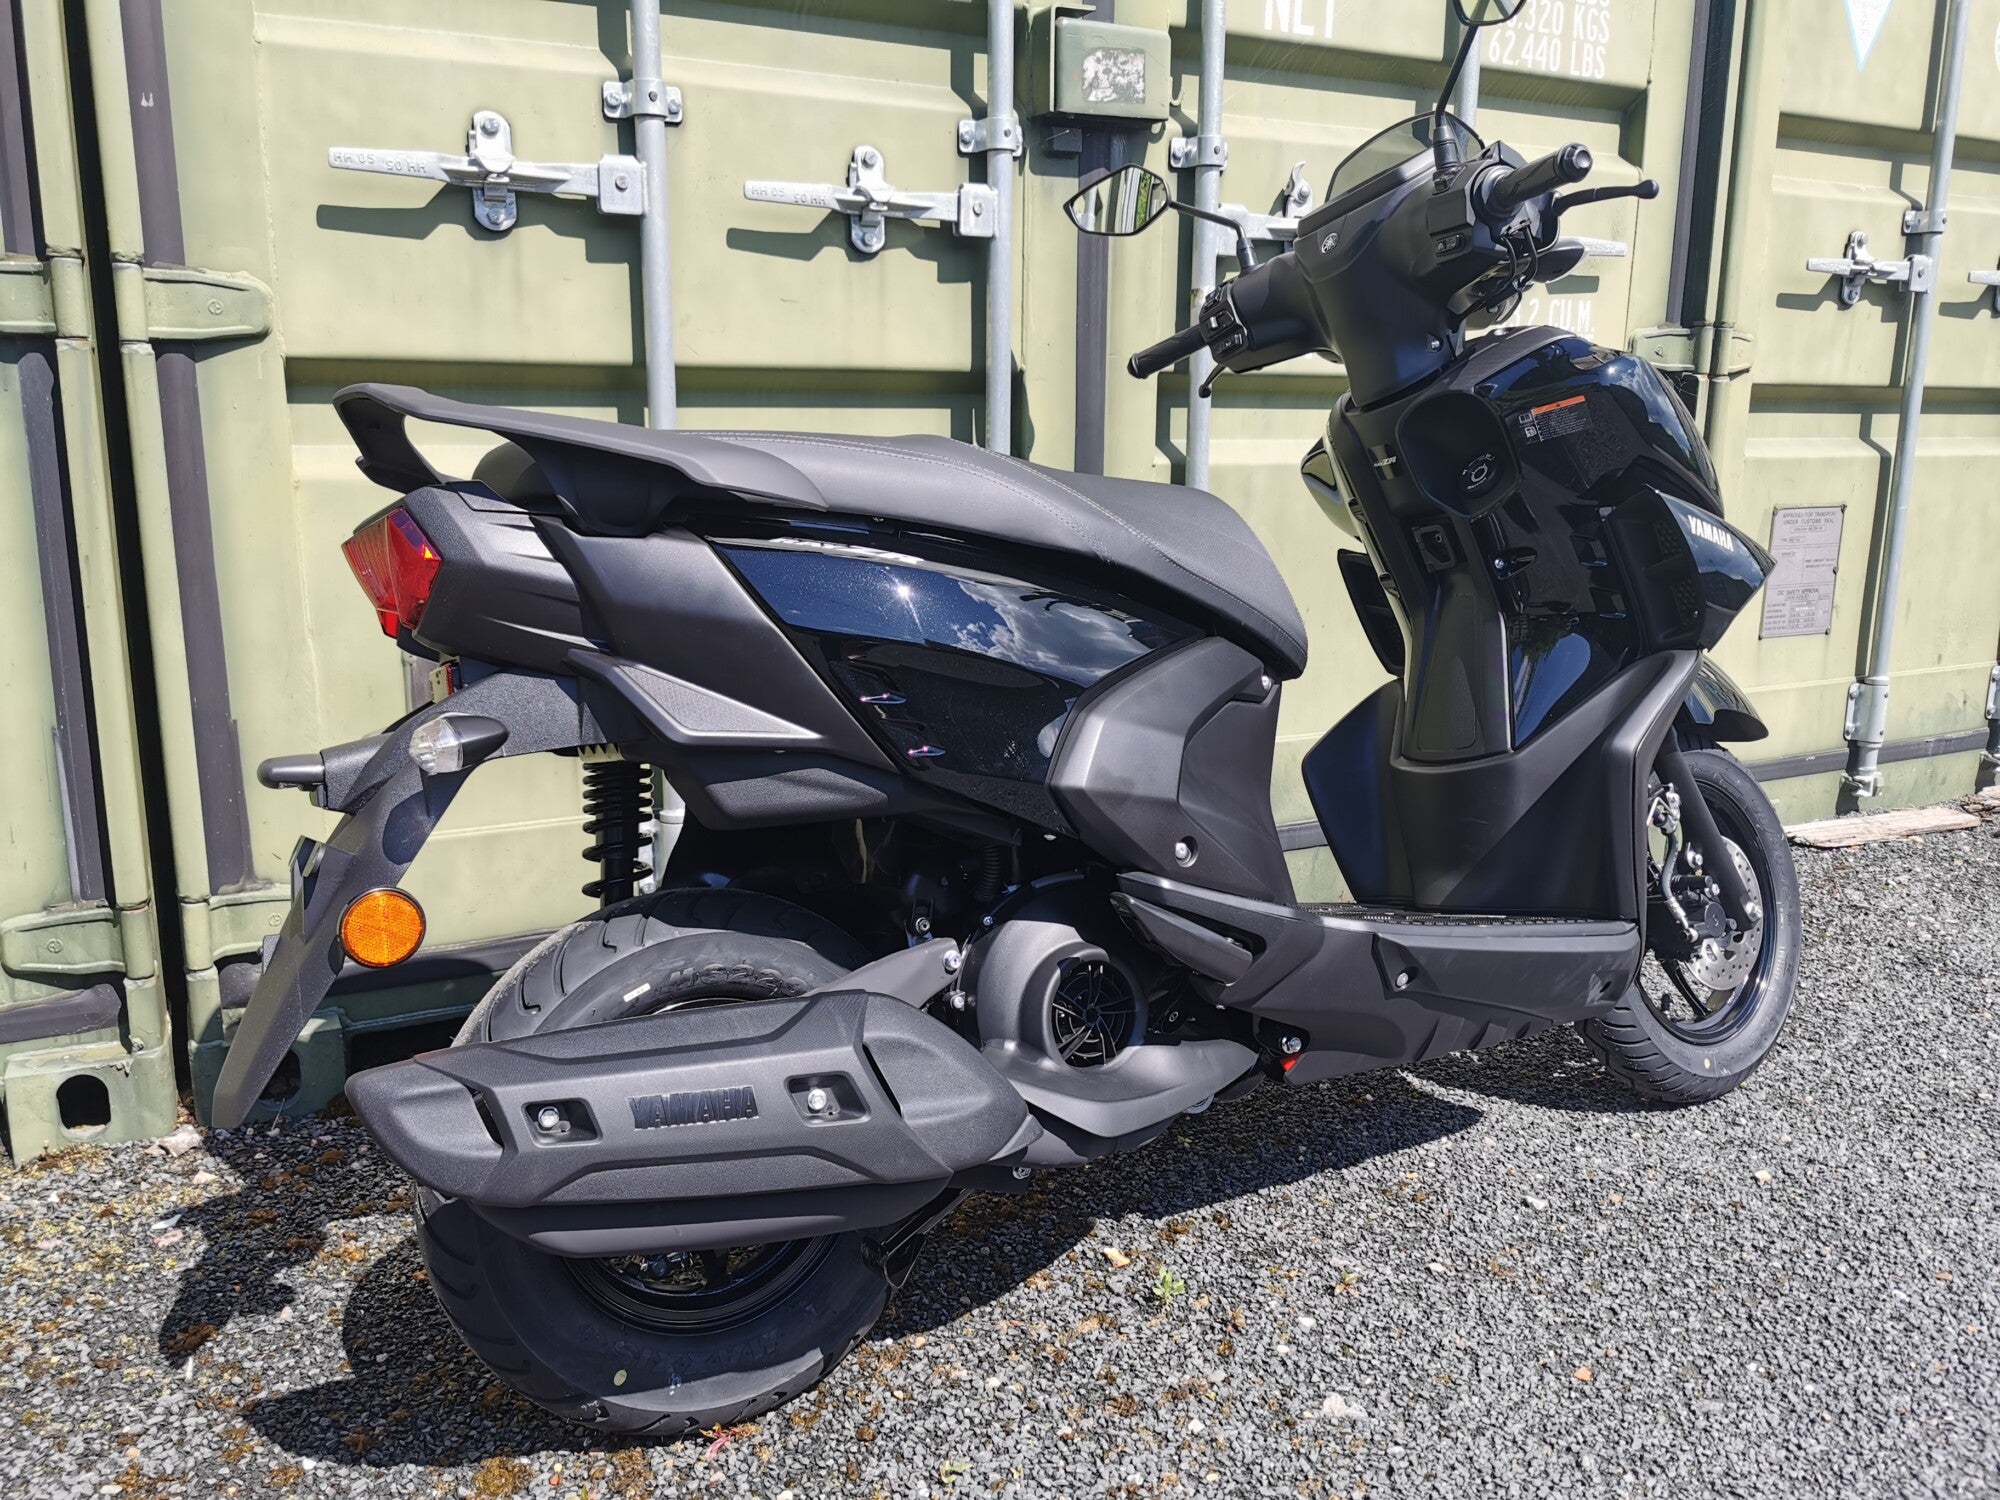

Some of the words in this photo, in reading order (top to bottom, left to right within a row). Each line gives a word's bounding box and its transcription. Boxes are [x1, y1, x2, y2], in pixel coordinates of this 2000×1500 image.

[1499, 0, 1564, 36] ,320
[1573, 4, 1611, 44] KGS
[1488, 28, 1562, 72] 62,440
[1570, 40, 1606, 80] LBS
[1687, 514, 1734, 552] YAMAHA
[625, 1085, 759, 1131] YAMAHA
